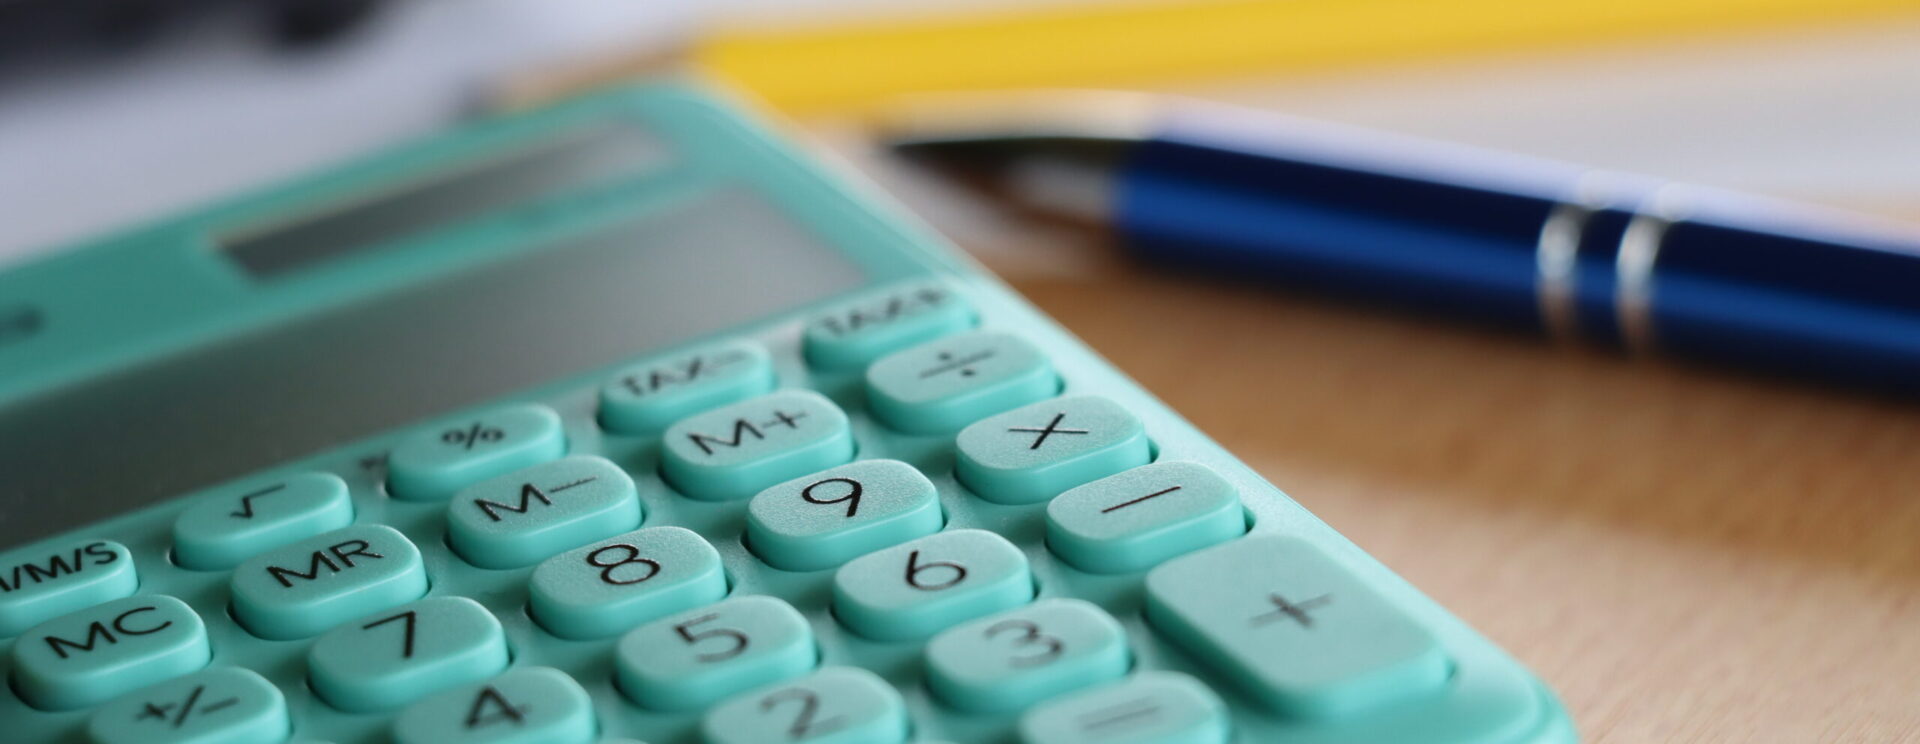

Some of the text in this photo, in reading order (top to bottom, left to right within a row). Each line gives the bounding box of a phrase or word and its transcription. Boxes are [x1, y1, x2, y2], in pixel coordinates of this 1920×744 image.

[441, 423, 506, 451] %
[686, 410, 808, 456] M+
[802, 477, 862, 518] 9
[266, 538, 384, 588] MR
[586, 543, 661, 585] 8
[906, 550, 968, 591] 6
[43, 606, 173, 660] MC
[361, 610, 417, 659] 7
[673, 613, 748, 664] 5
[983, 618, 1065, 669] 3
[464, 685, 532, 729] 4
[758, 687, 850, 739] 2
